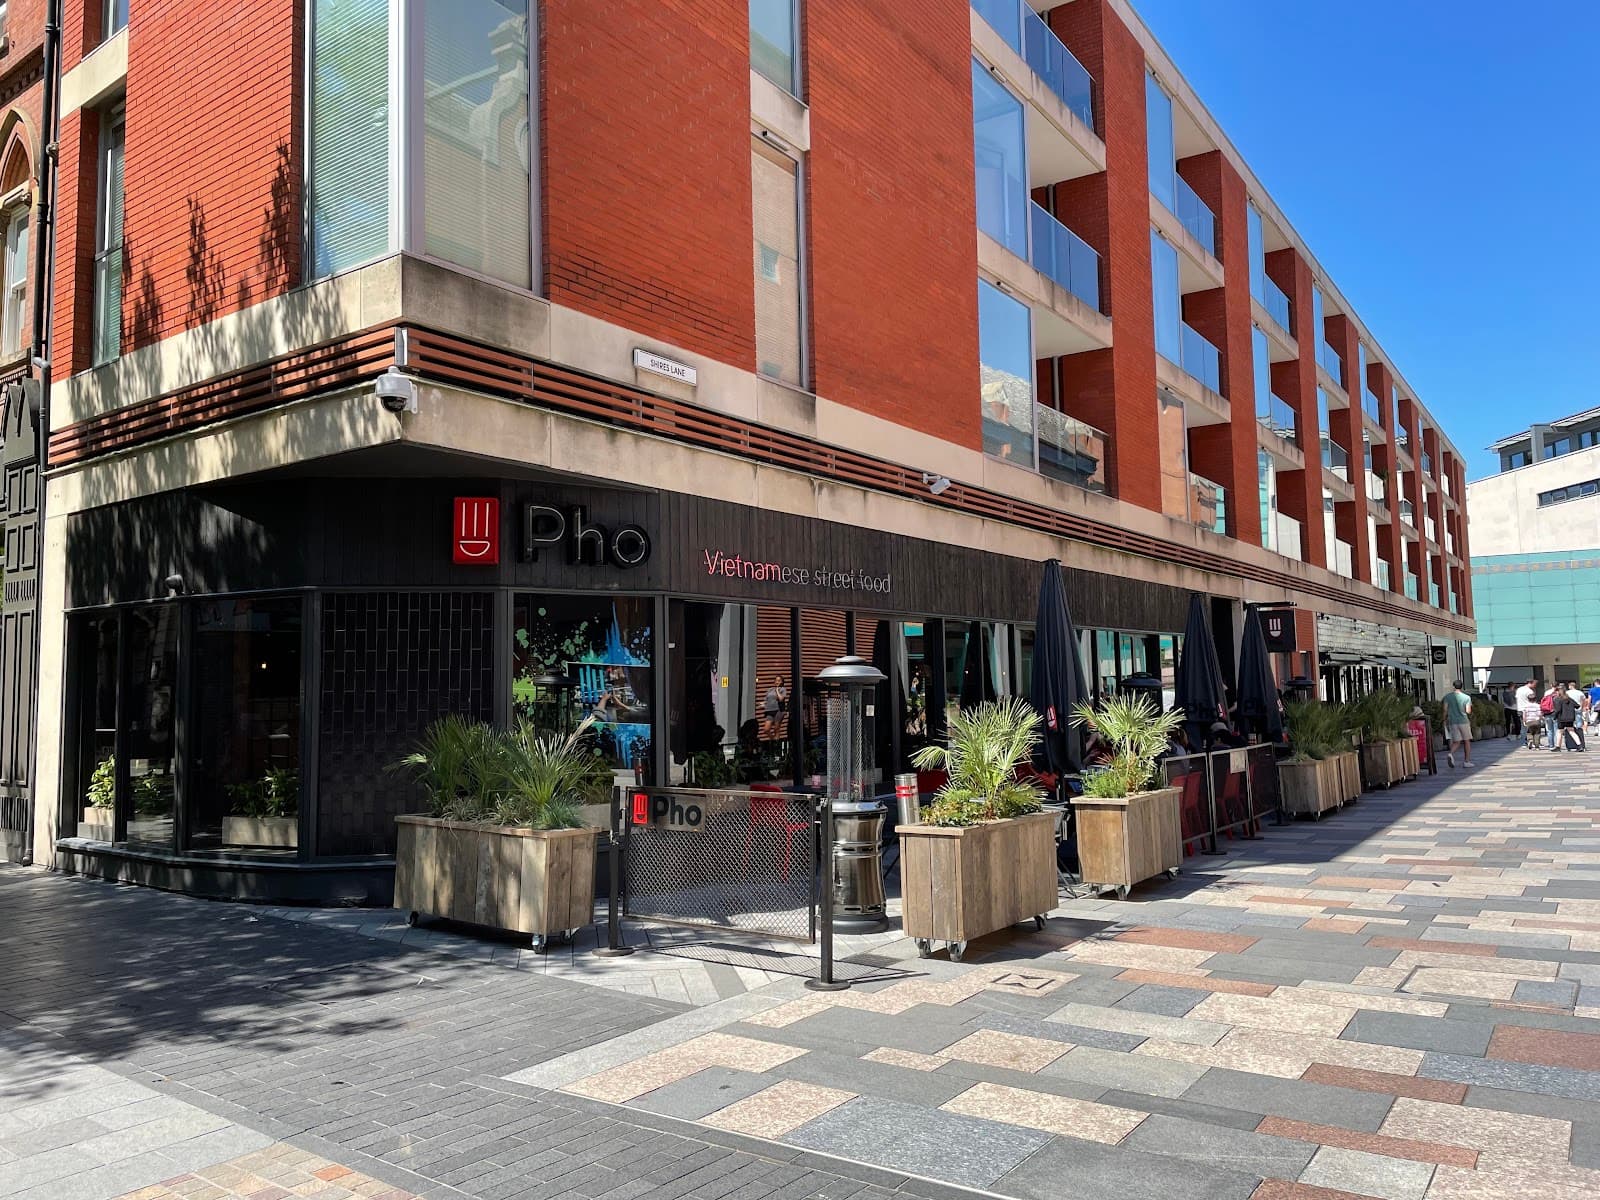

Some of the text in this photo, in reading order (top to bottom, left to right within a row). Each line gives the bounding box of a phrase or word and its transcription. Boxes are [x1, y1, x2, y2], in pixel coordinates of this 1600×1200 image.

[650, 359, 686, 377] SHIRES LANE
[518, 503, 651, 568] Pho
[704, 549, 891, 593] Vietnamese street food
[653, 795, 702, 826] Pho
